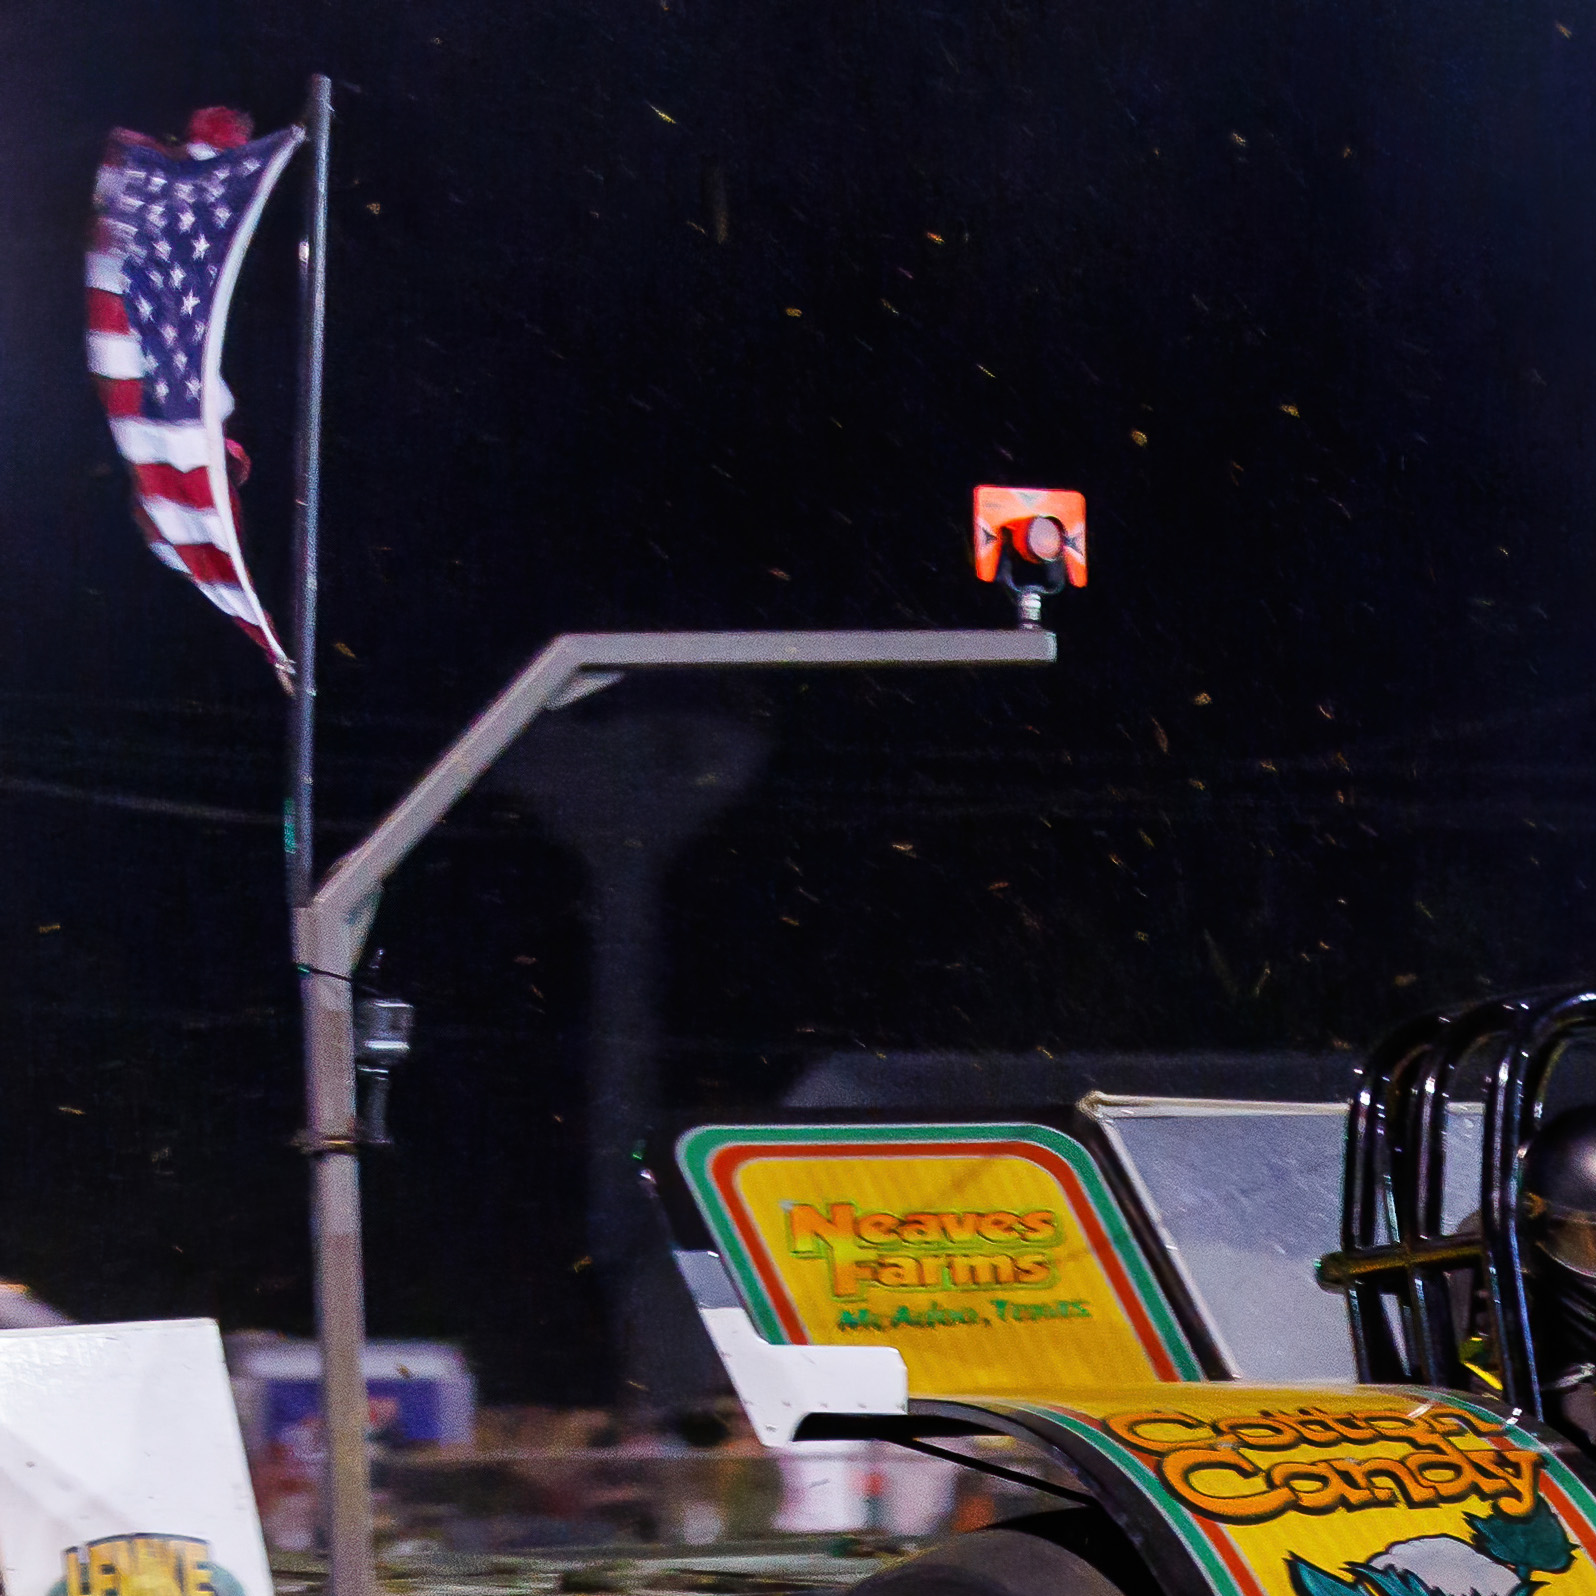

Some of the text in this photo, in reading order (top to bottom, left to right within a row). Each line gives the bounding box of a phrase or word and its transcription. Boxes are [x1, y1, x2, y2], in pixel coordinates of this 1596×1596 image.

[786, 1200, 1062, 1252] Neaves
[832, 1250, 1056, 1300] Farms
[1104, 1406, 1506, 1456] Cotton
[1159, 1437, 1544, 1525] Candy
